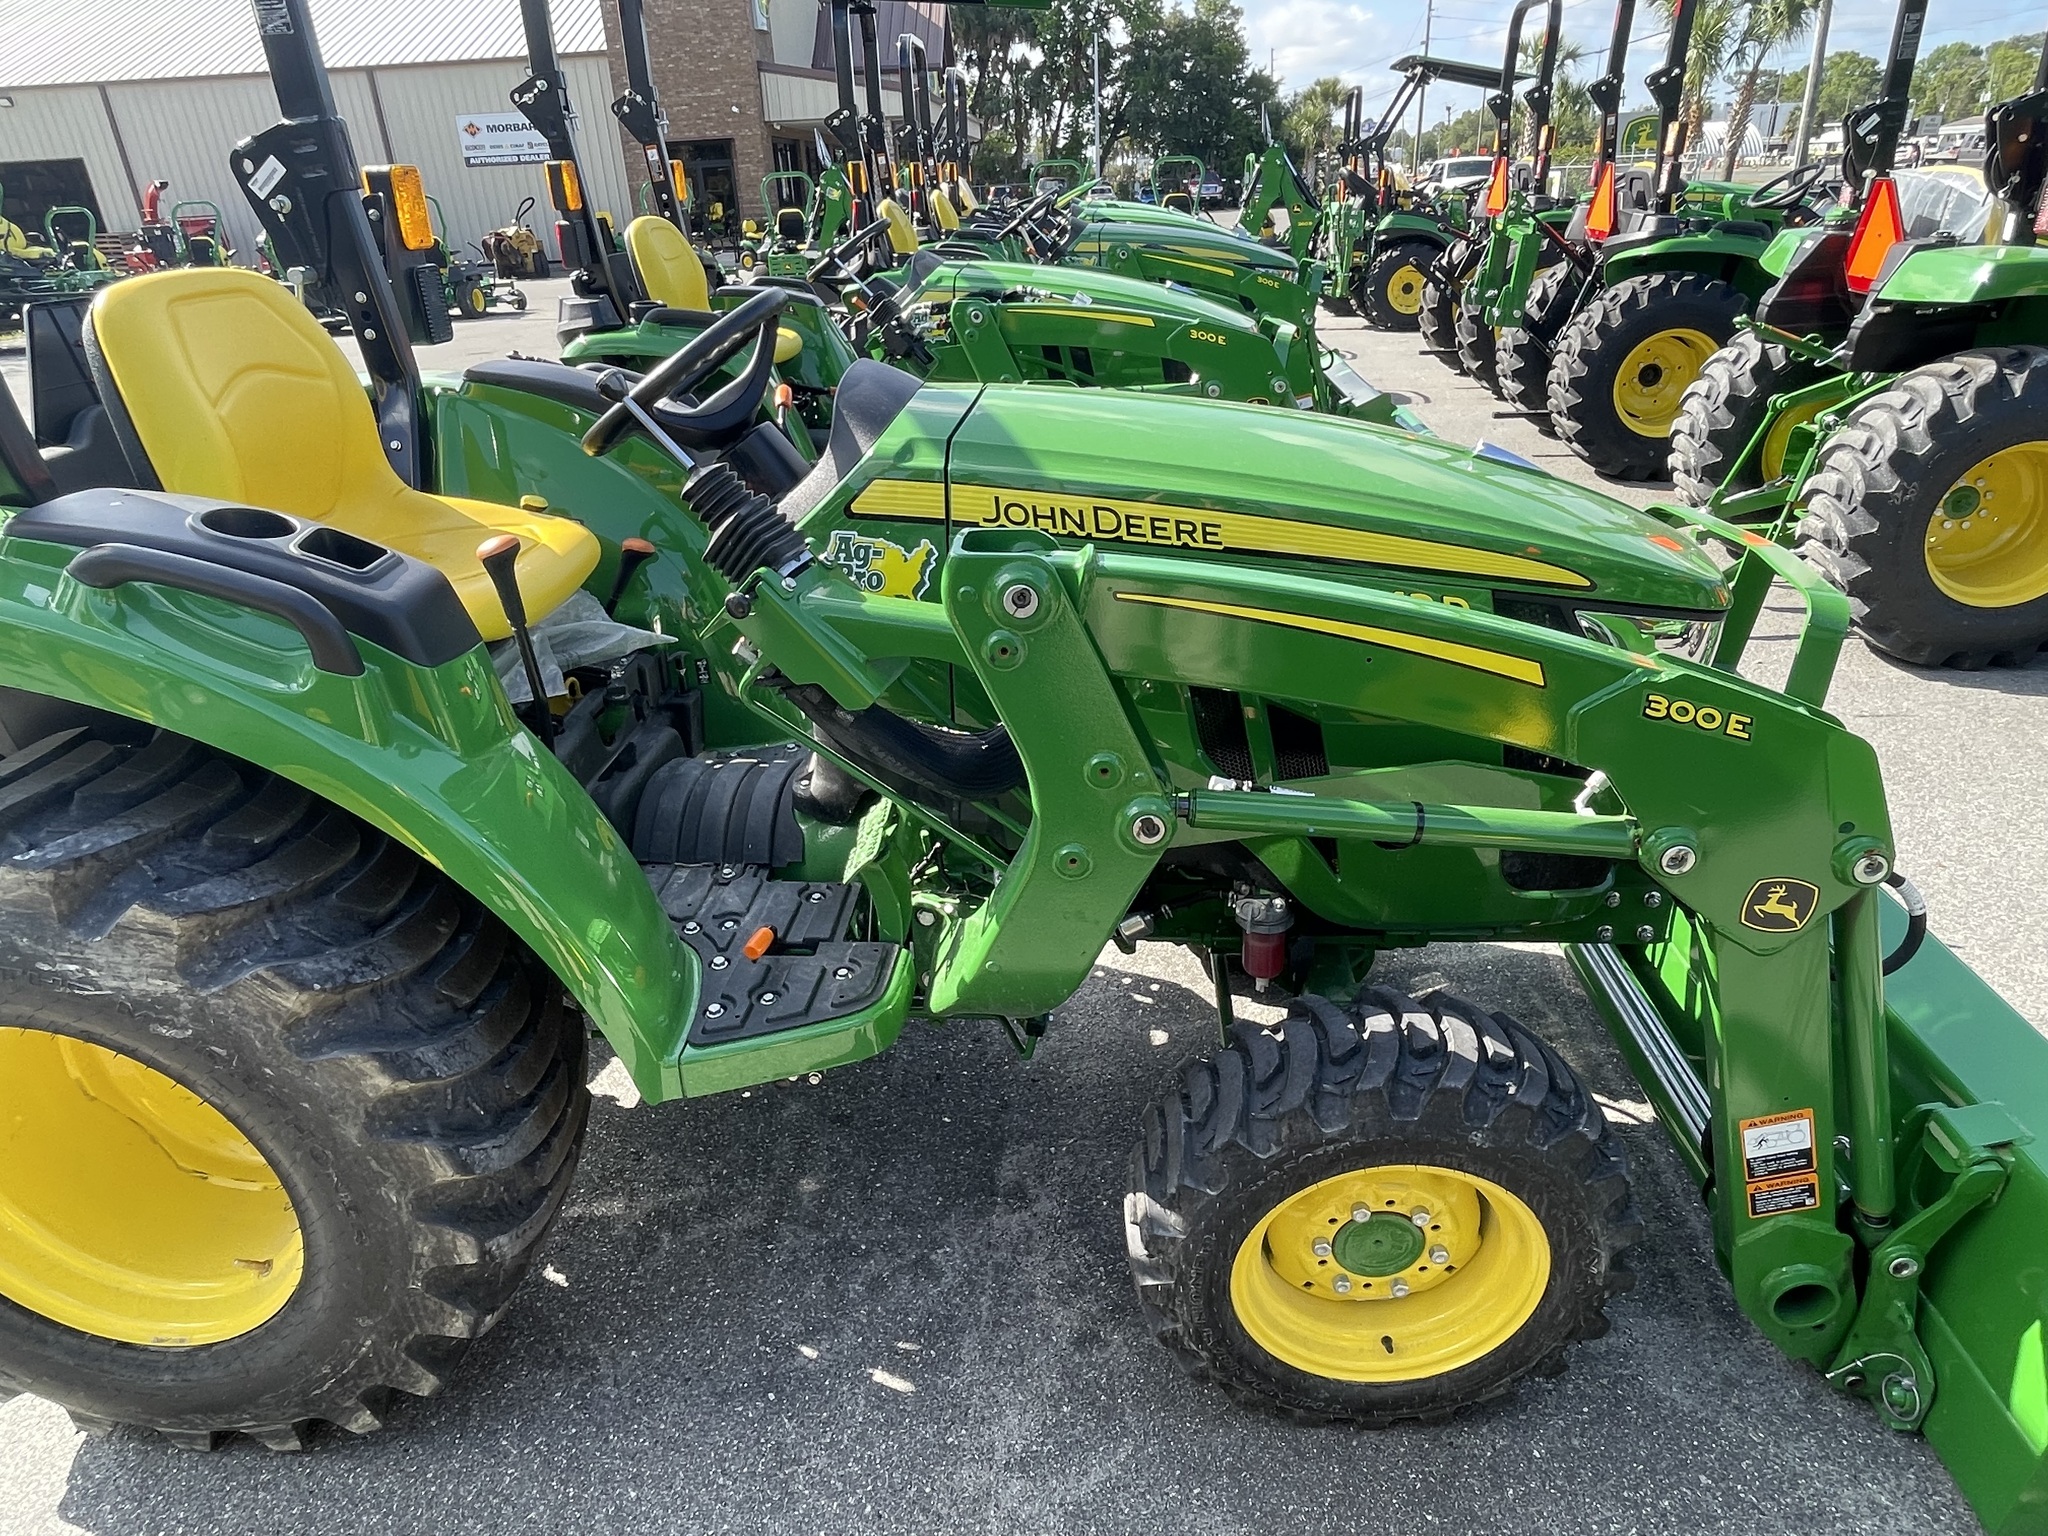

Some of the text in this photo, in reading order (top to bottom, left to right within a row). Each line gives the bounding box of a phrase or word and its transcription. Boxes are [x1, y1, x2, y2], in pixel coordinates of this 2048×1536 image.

[486, 123, 538, 133] MORBAR
[469, 154, 551, 164] AUTHORIZED DEALER
[983, 496, 1223, 546] JOHN DEERE
[1759, 1112, 1804, 1126] WARNING
[1766, 1177, 1810, 1189] WARNING
